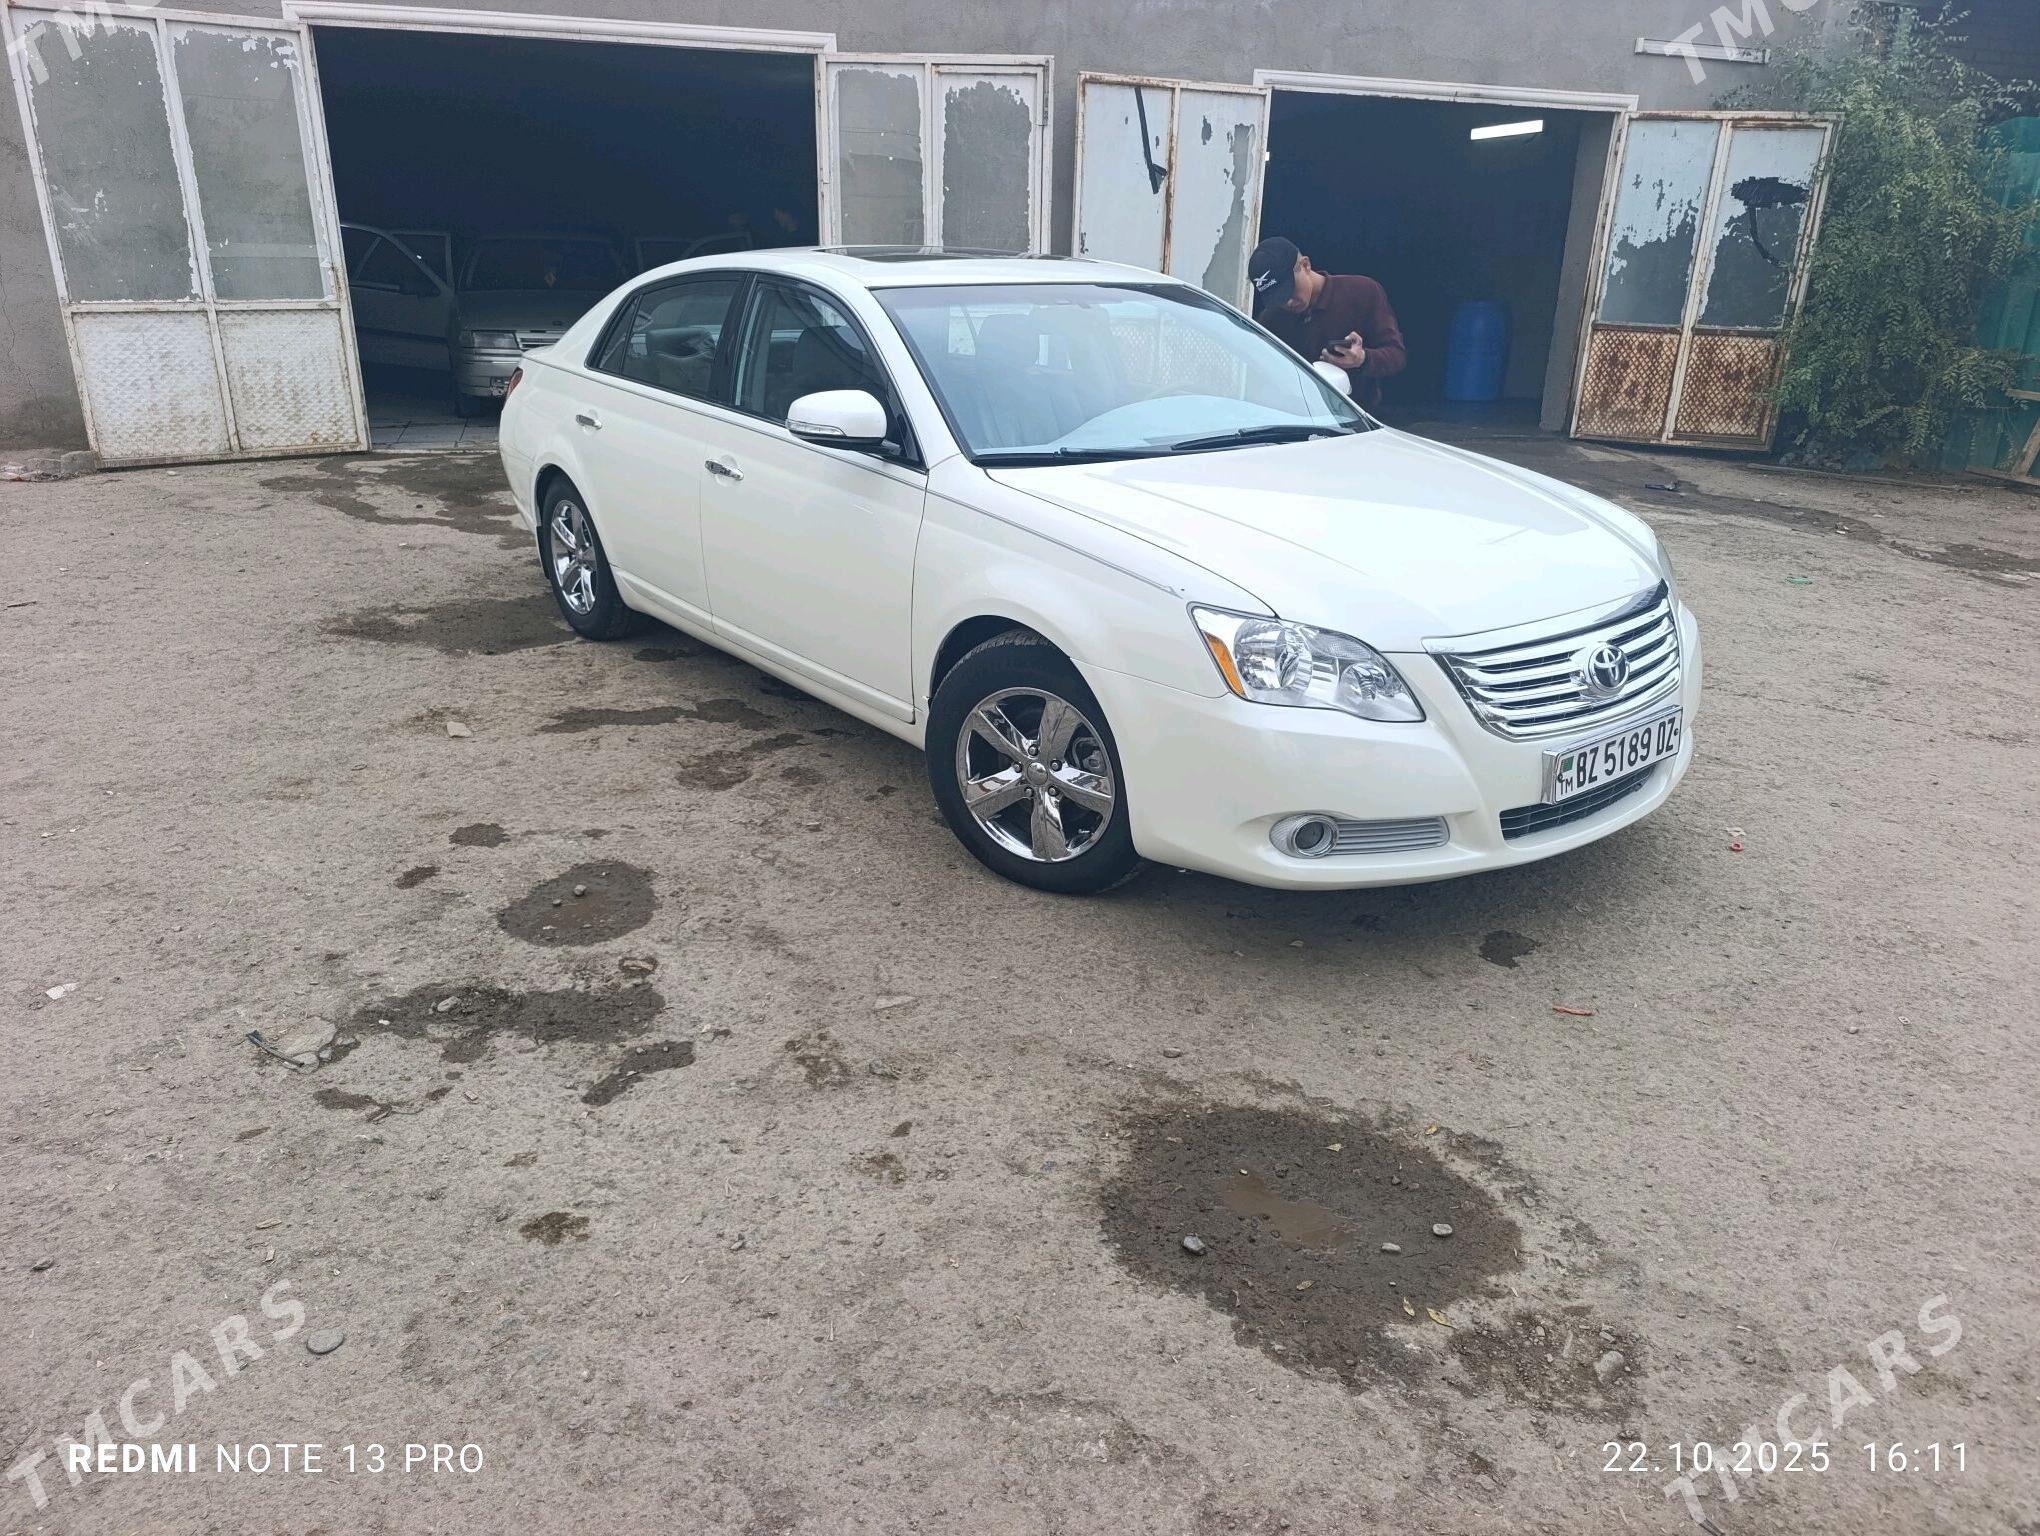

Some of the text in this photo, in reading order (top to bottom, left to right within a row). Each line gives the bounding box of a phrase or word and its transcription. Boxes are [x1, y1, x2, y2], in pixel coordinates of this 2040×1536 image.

[1576, 716, 1676, 789] BZ 5189 DZ
